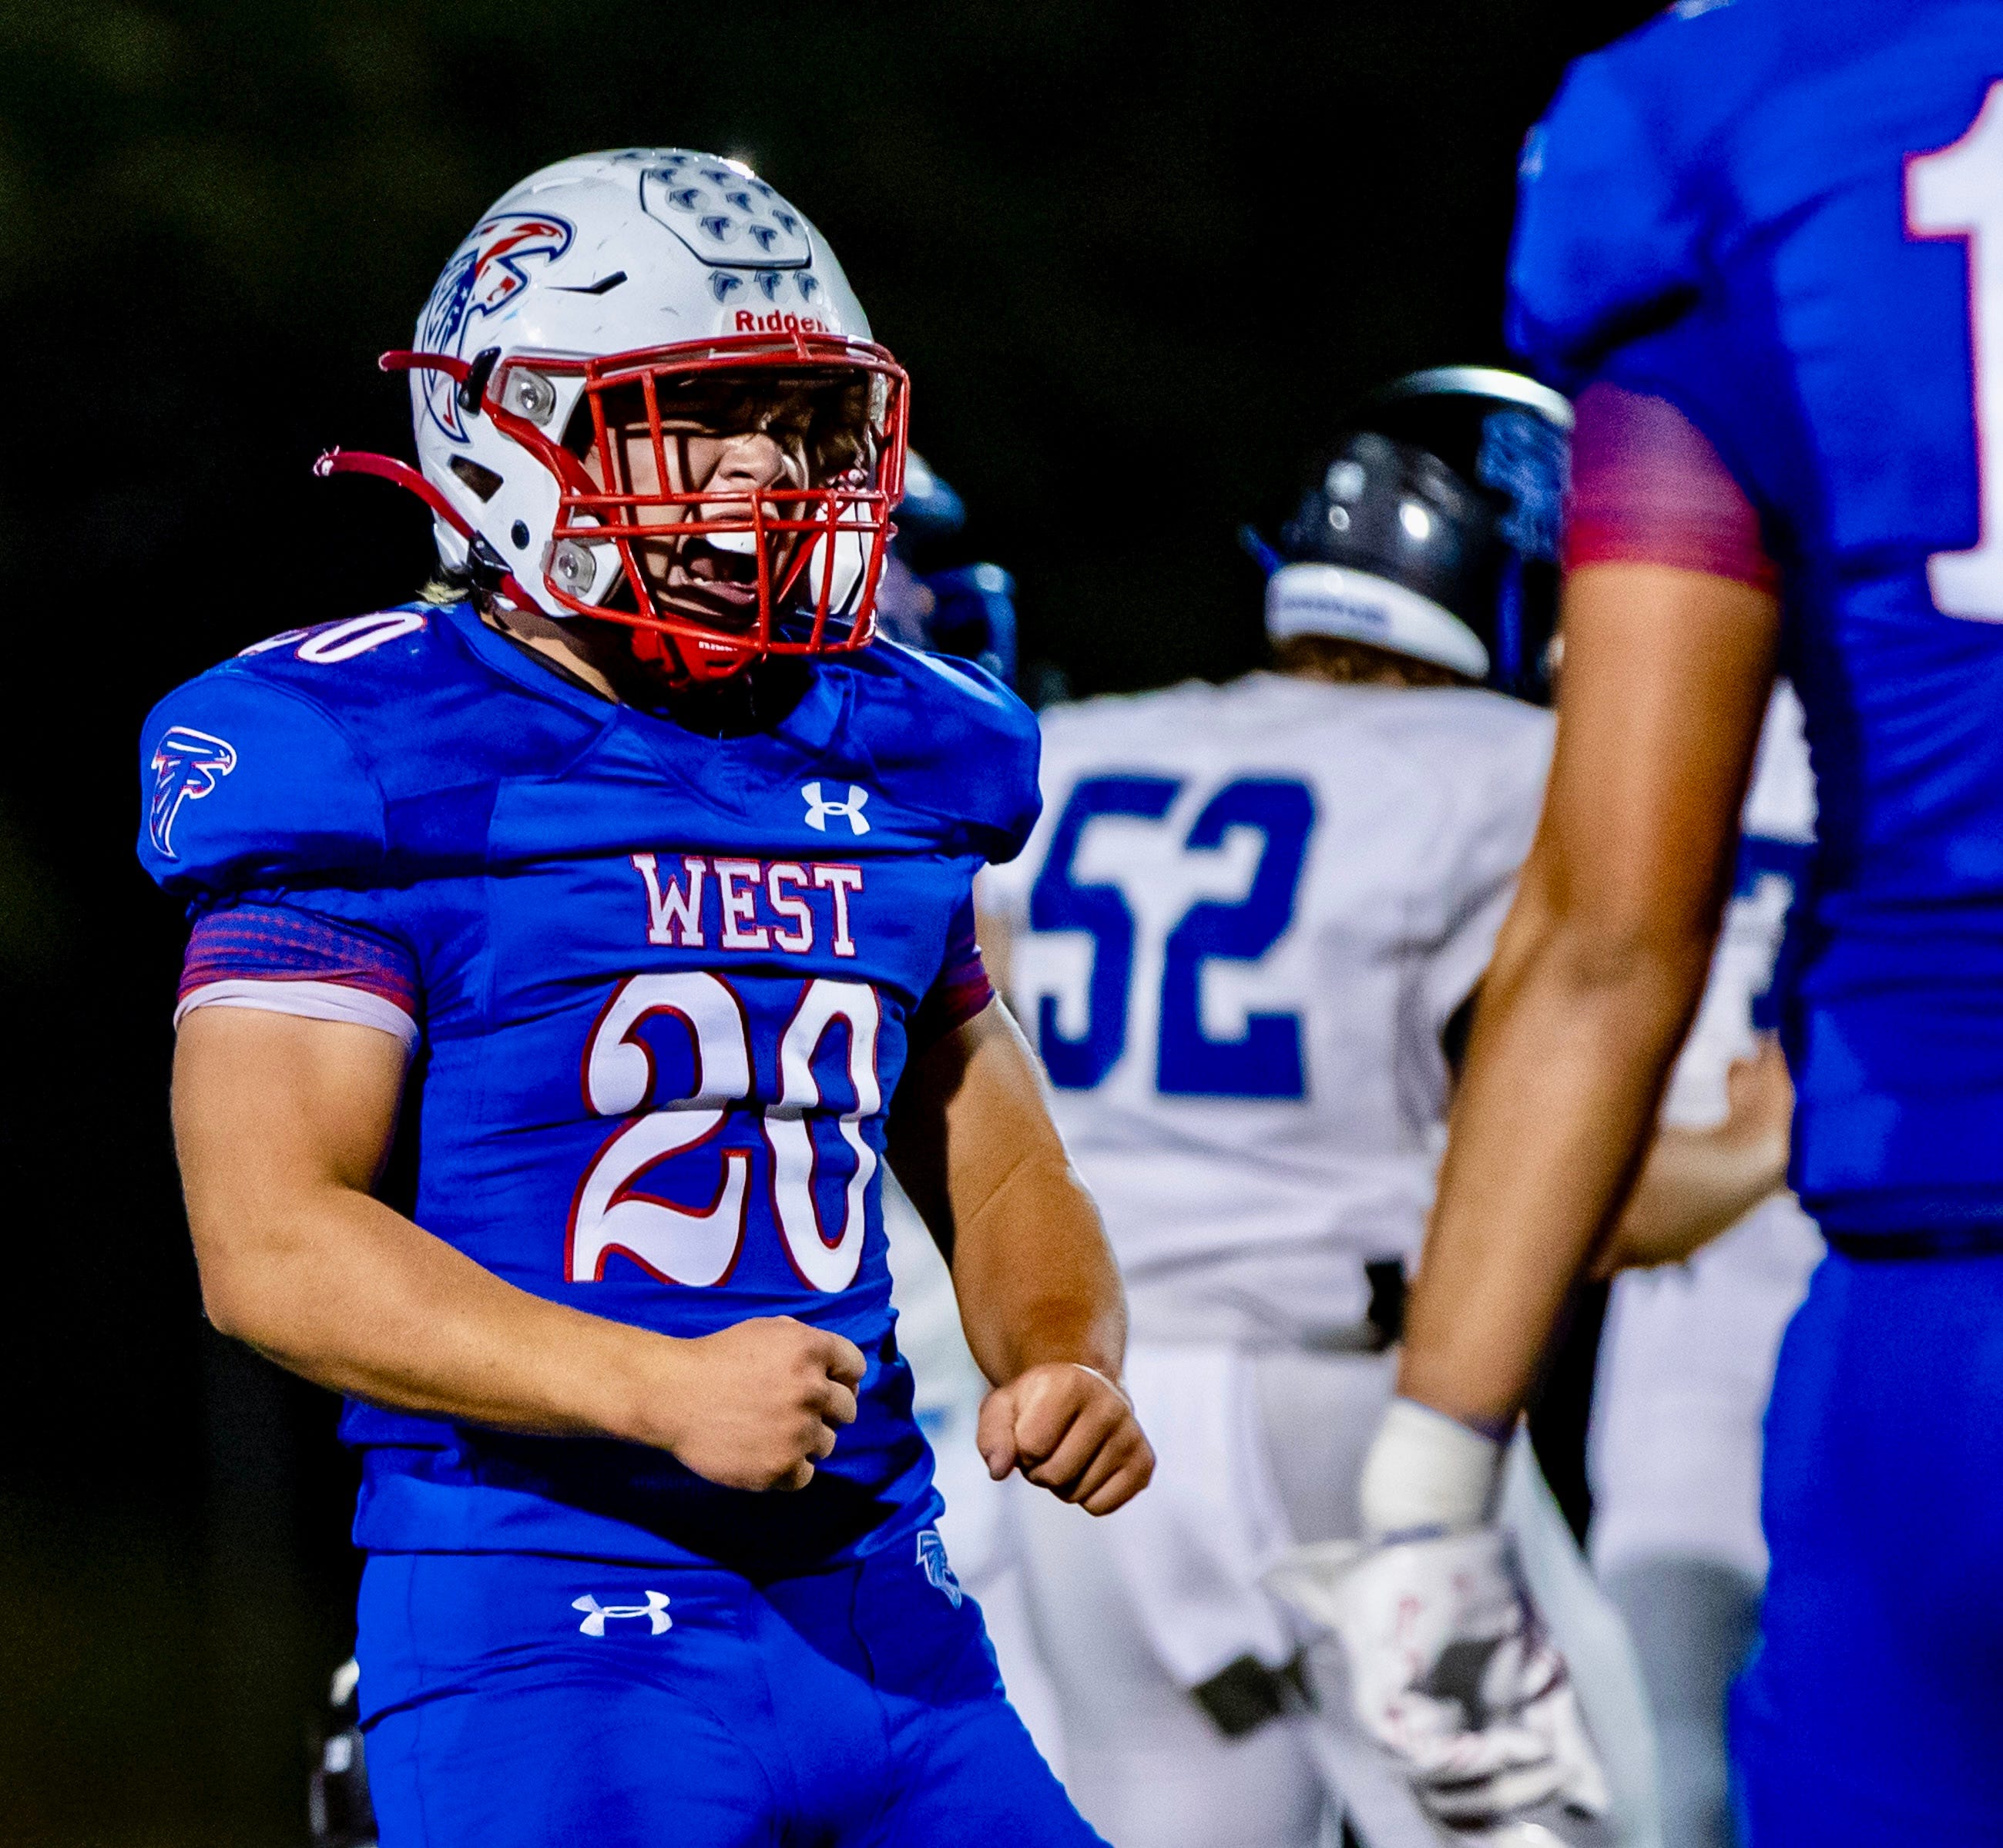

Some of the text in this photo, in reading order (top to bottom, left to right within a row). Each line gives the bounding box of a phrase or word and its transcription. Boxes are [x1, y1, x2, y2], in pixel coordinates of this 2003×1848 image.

[630, 851, 864, 957] WEST
[1030, 776, 1316, 1100] 52
[564, 971, 881, 1293] 20
